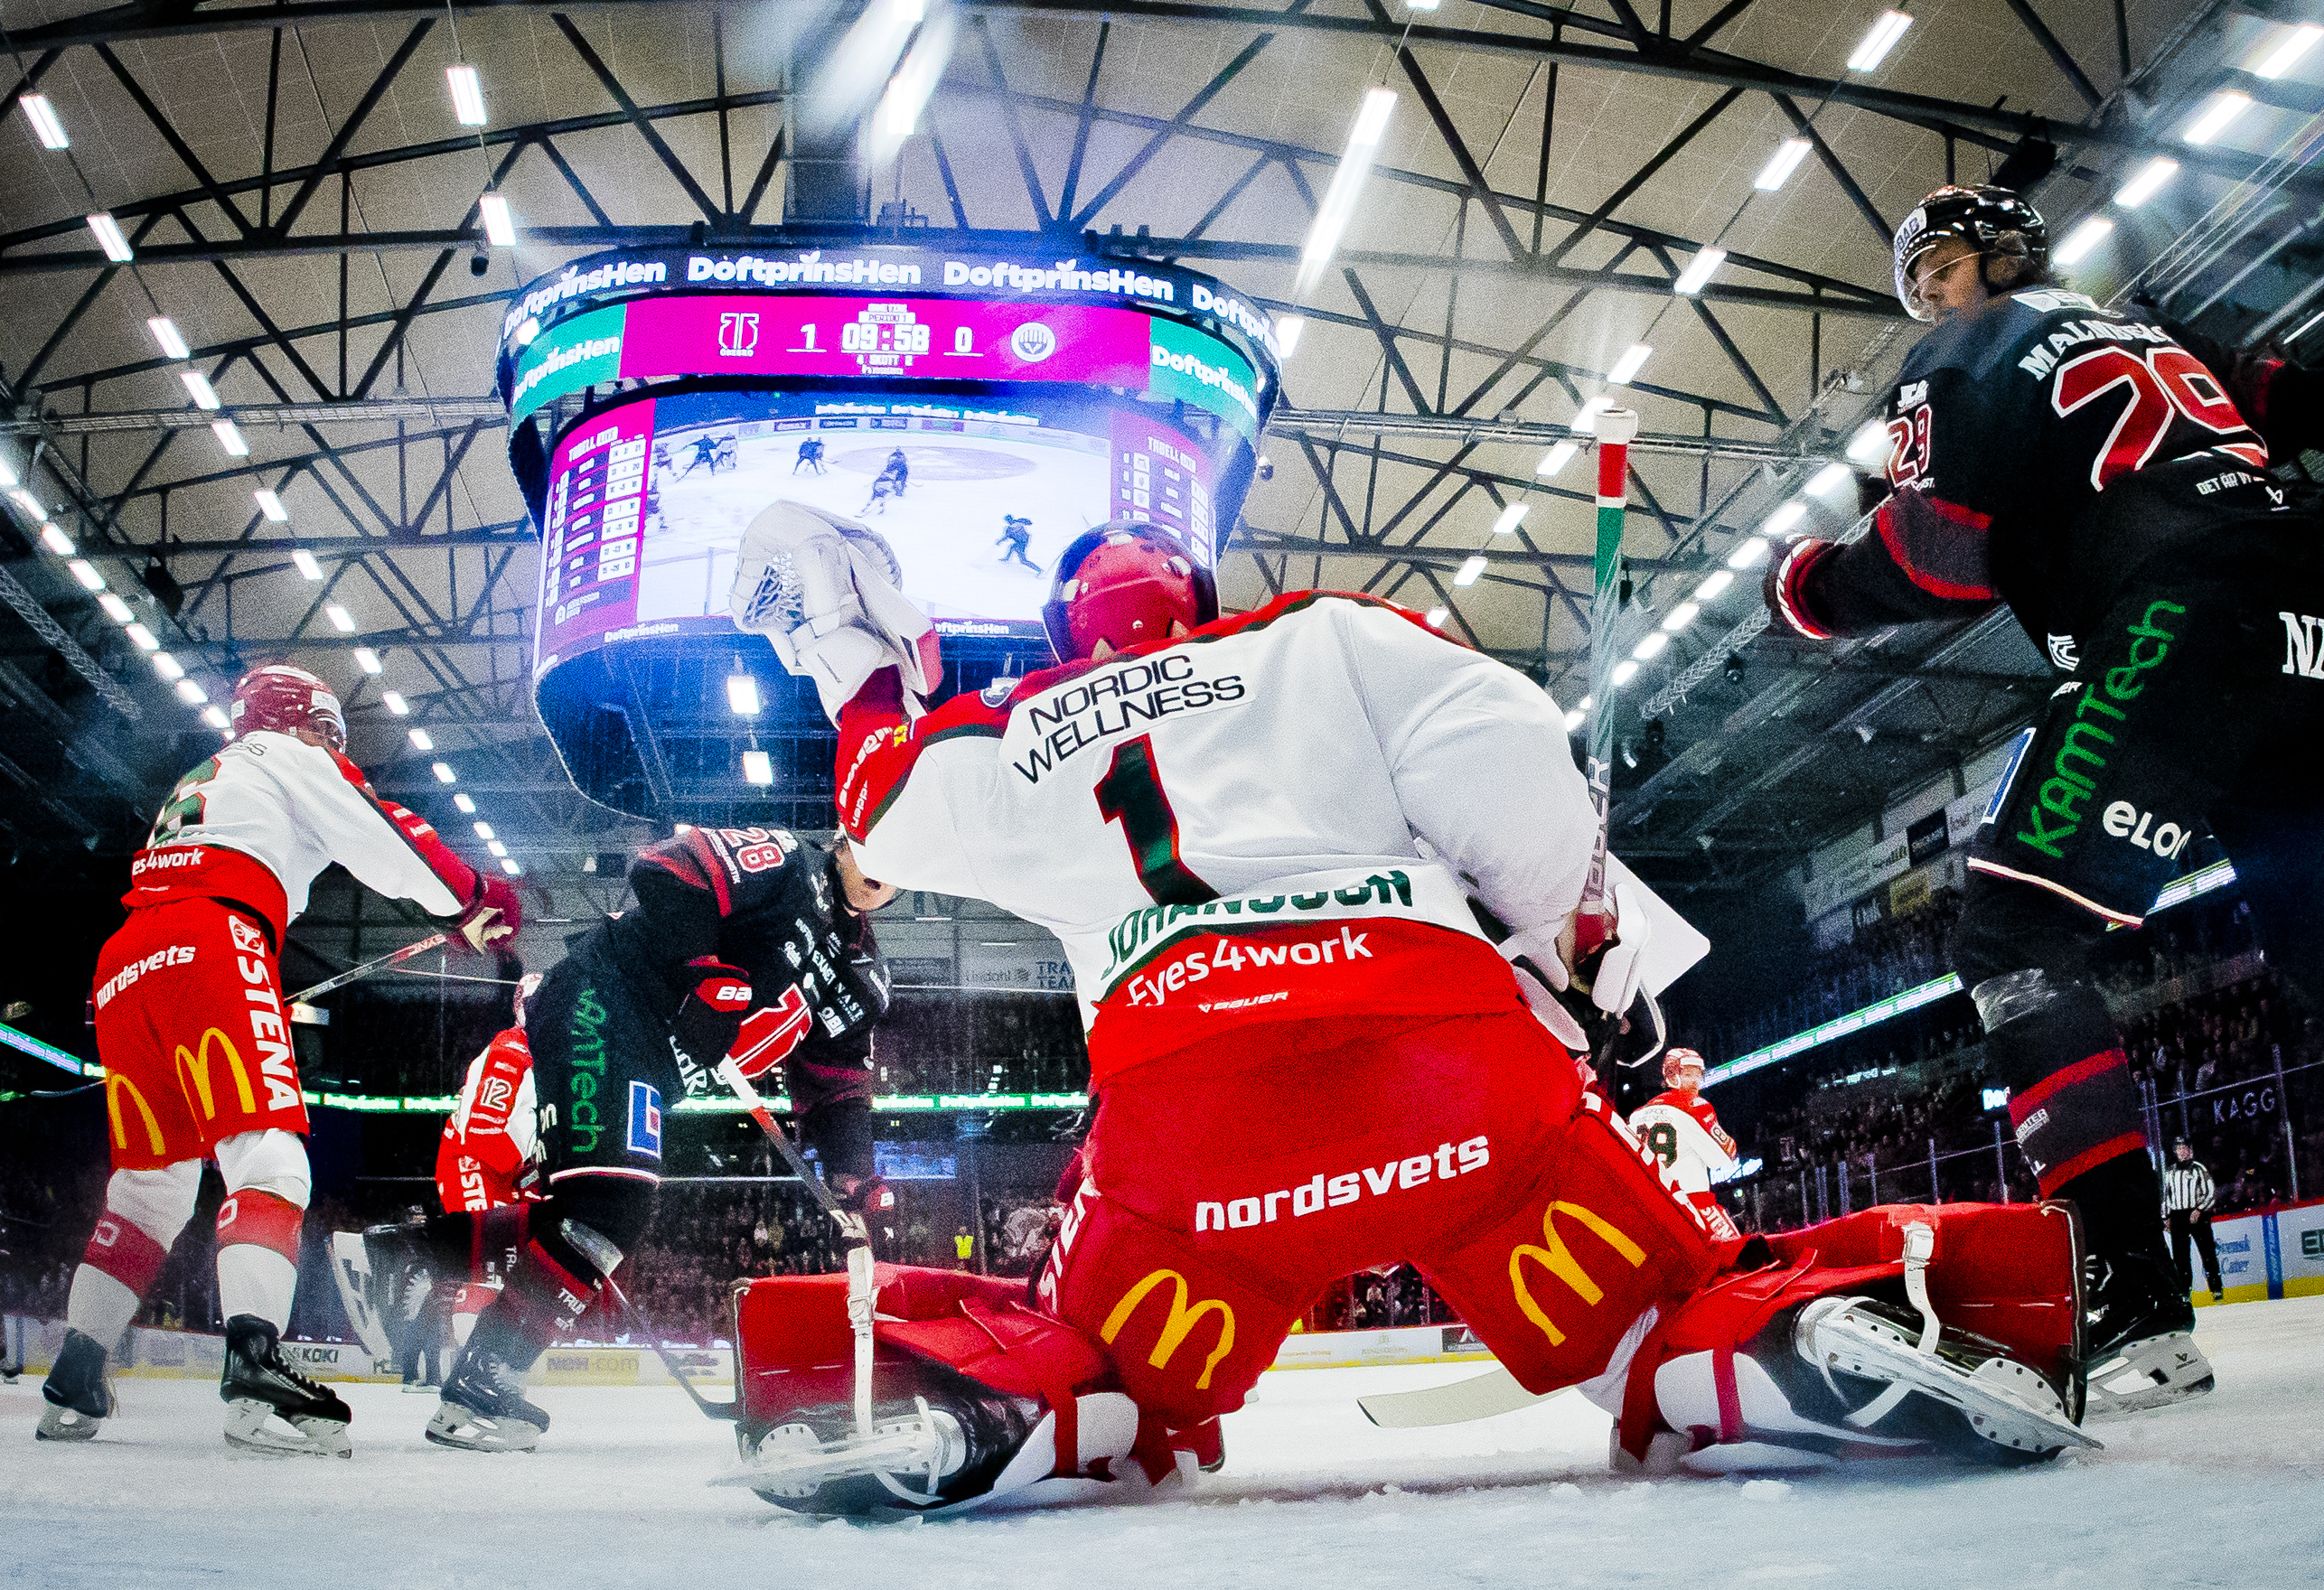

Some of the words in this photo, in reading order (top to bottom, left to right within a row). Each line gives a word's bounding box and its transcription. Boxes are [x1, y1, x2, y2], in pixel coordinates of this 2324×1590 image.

[687, 252, 921, 285] DoftprinsHen
[943, 258, 1174, 302] DoftprinsHen
[801, 323, 815, 350] 1
[842, 323, 930, 352] 09:58
[954, 326, 973, 352] 0
[934, 621, 1009, 634] oftprinsHen
[1029, 655, 1193, 735] NORDIC
[1013, 676, 1245, 784] WELLNESS
[1093, 733, 1222, 905] 1
[132, 848, 205, 875] es4work
[718, 827, 785, 873] 28
[96, 946, 195, 1010] nordsvets
[1127, 926, 1373, 1006] Eyes4work
[1214, 992, 1289, 1010] BAUER
[238, 956, 299, 1111] STENA
[479, 1077, 512, 1111] 12
[1196, 1135, 1490, 1231] nordsvets
